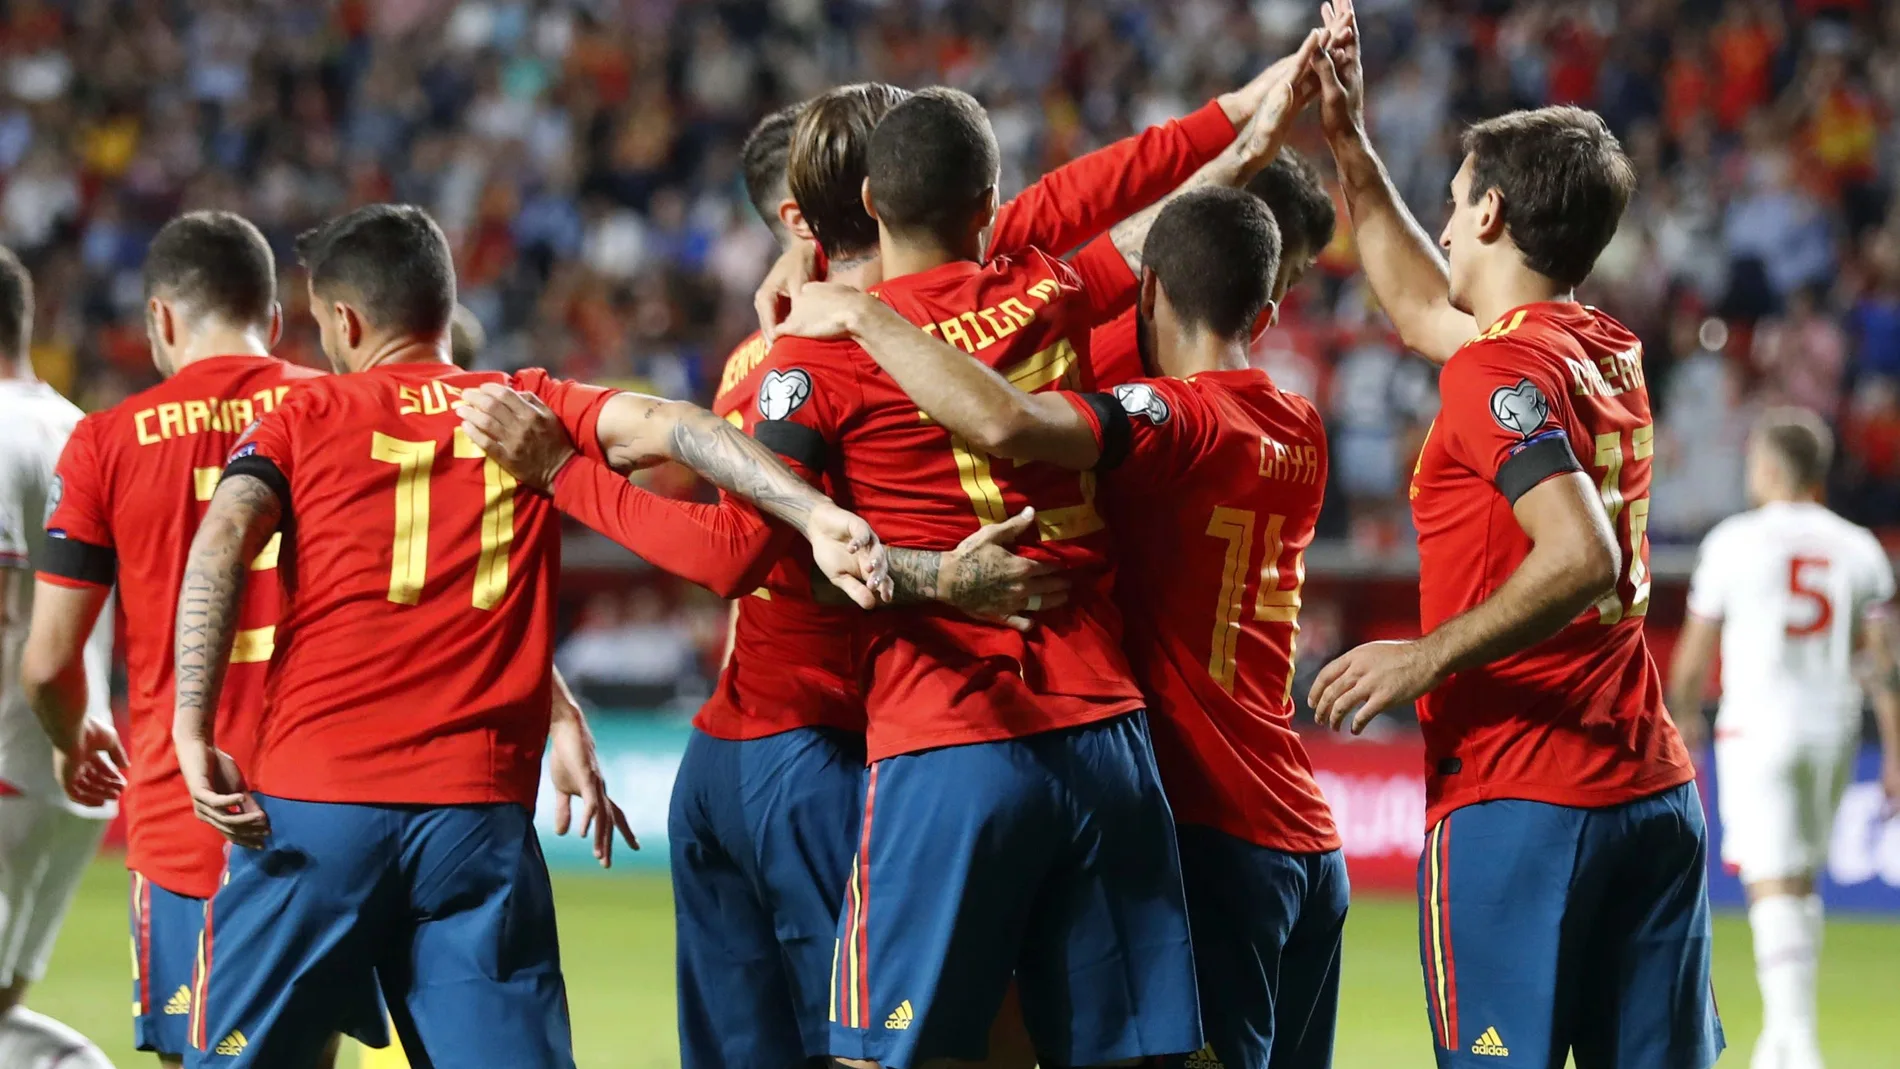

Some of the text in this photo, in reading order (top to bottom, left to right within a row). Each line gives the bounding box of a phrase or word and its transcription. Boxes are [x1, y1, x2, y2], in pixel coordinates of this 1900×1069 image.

[370, 425, 518, 612] 11
[1204, 504, 1307, 708] 14
[1784, 555, 1834, 638] 5
[1471, 1044, 1509, 1057] adidas
